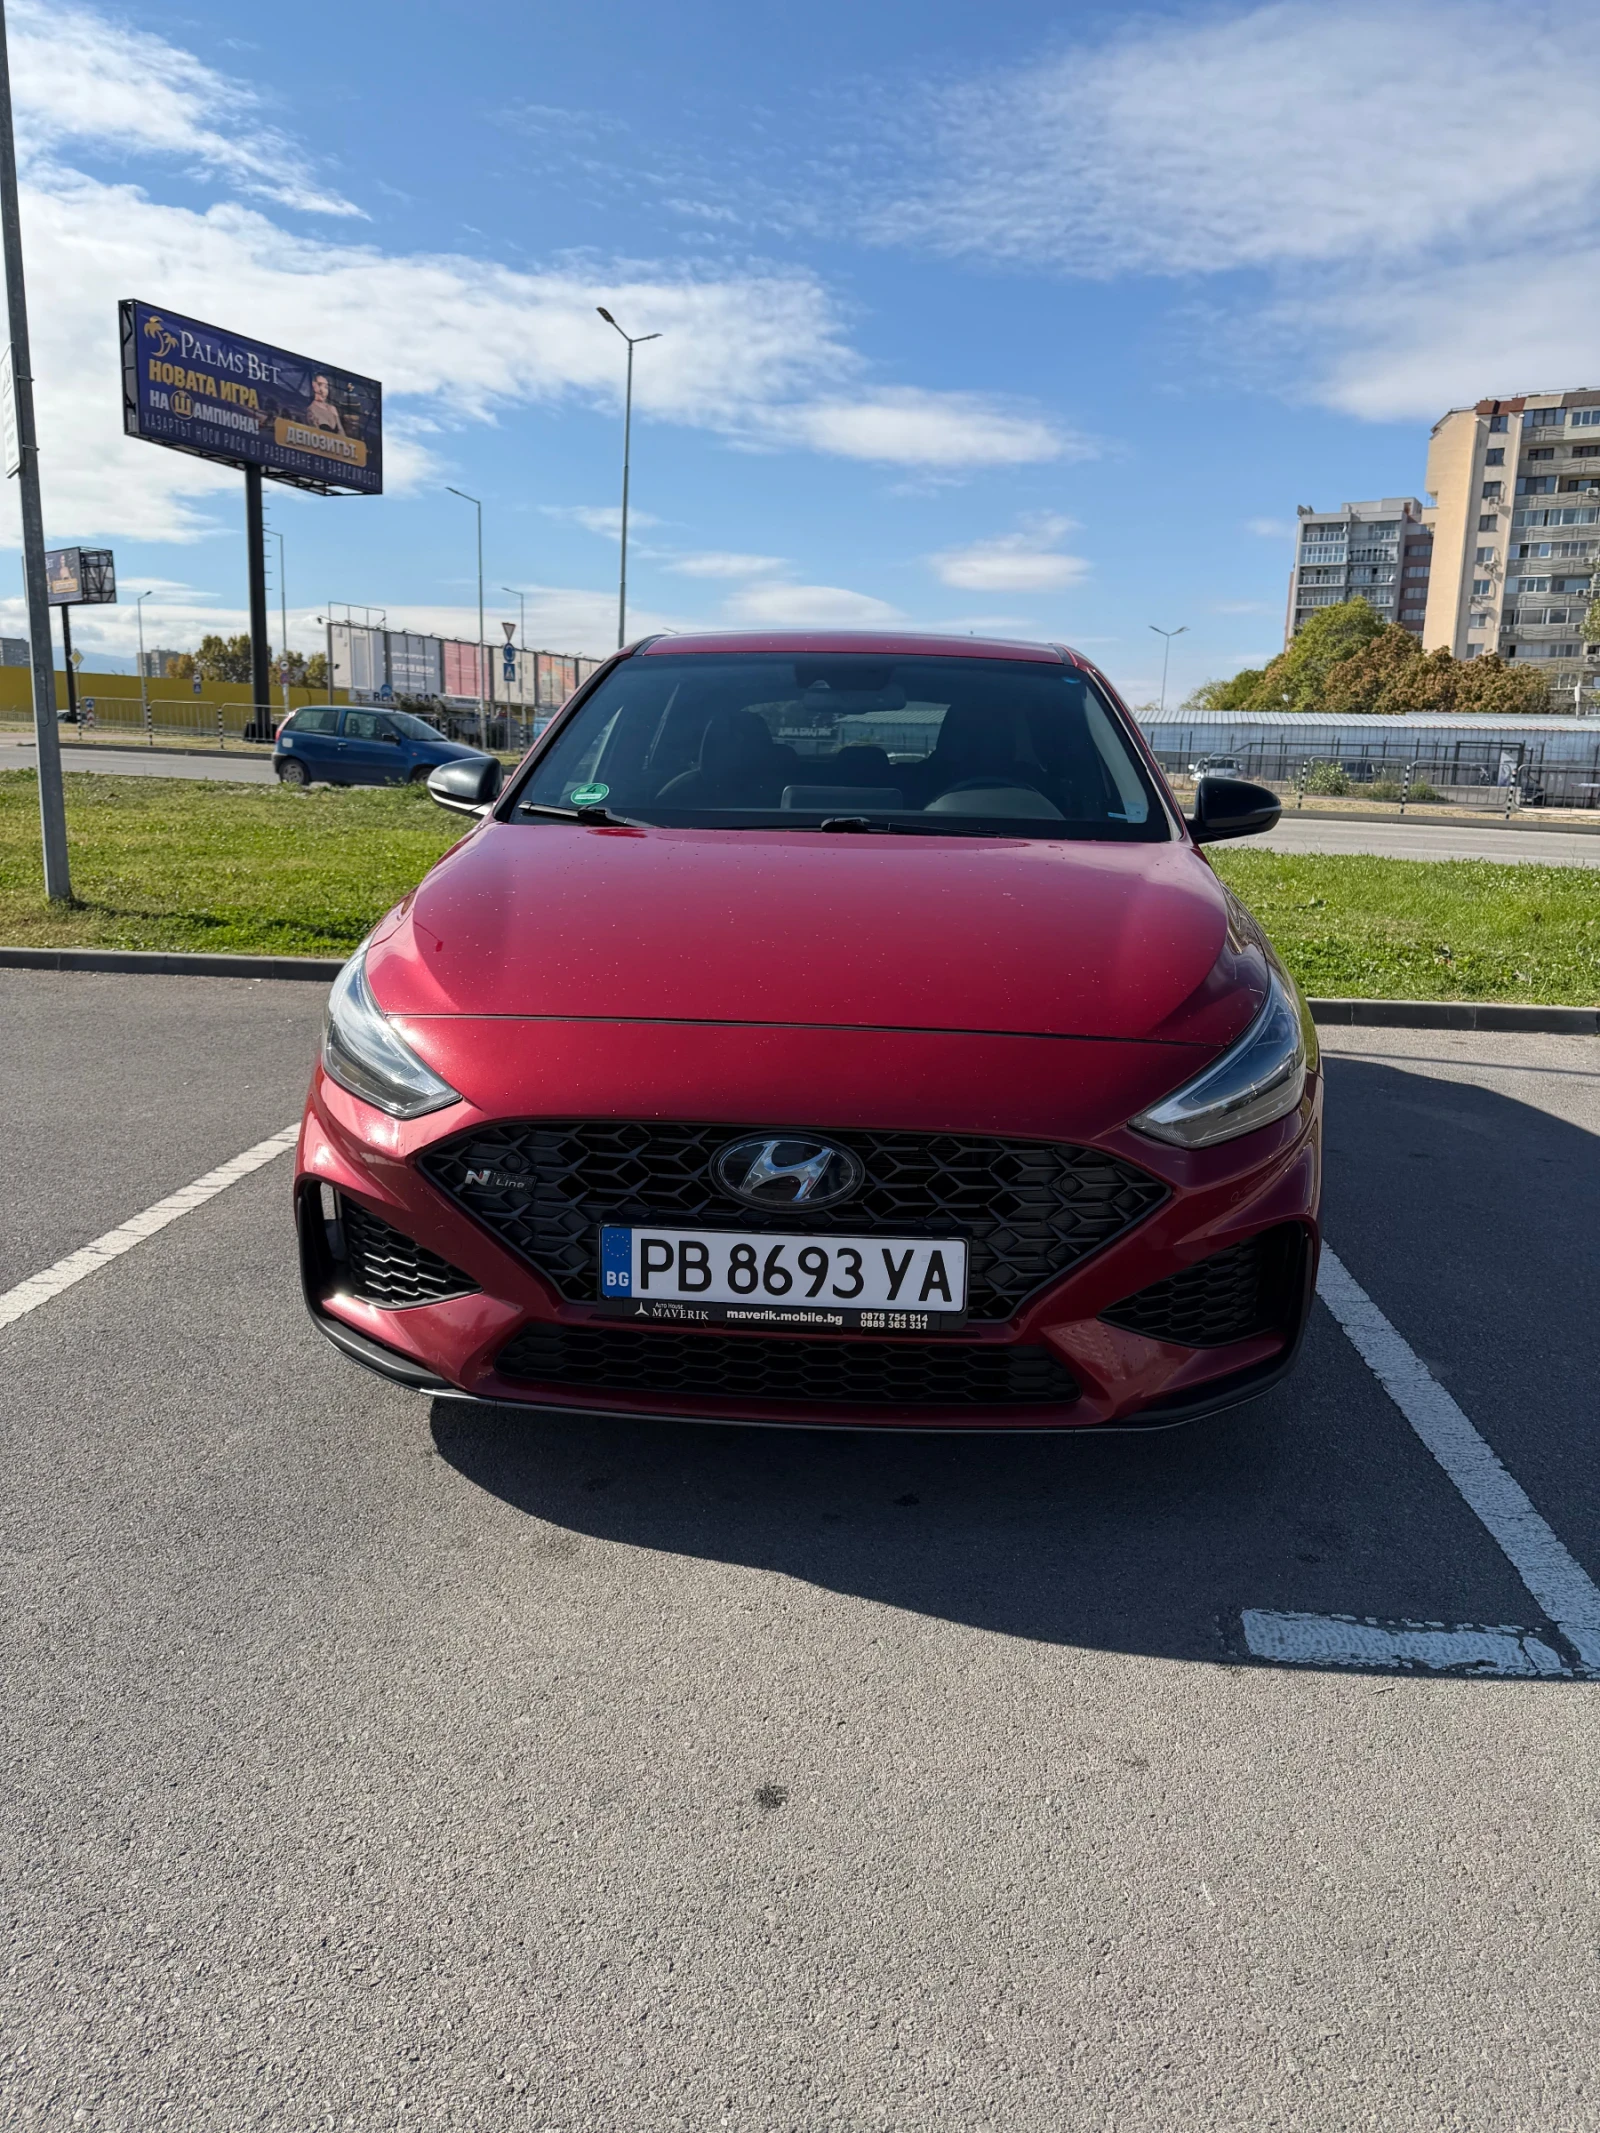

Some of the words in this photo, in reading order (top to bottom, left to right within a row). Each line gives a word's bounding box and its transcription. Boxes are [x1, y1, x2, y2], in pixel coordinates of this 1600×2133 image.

[149, 359, 218, 398] НОВАТА
[220, 380, 260, 410] ИГРА
[149, 389, 170, 411] НА
[464, 1170, 491, 1186] N
[496, 1179, 525, 1188] Line
[606, 1270, 629, 1287] BG
[640, 1238, 712, 1292] PB
[727, 1243, 864, 1299] 8693
[881, 1248, 952, 1302] YA
[652, 1307, 709, 1320] MAVERIK
[726, 1309, 843, 1325] maverik.mobile.bg
[860, 1312, 885, 1321] 0878
[888, 1313, 907, 1321] 754
[909, 1314, 928, 1322] 914
[860, 1320, 885, 1328] 0889
[888, 1321, 906, 1329] 363
[909, 1322, 927, 1330] 331
